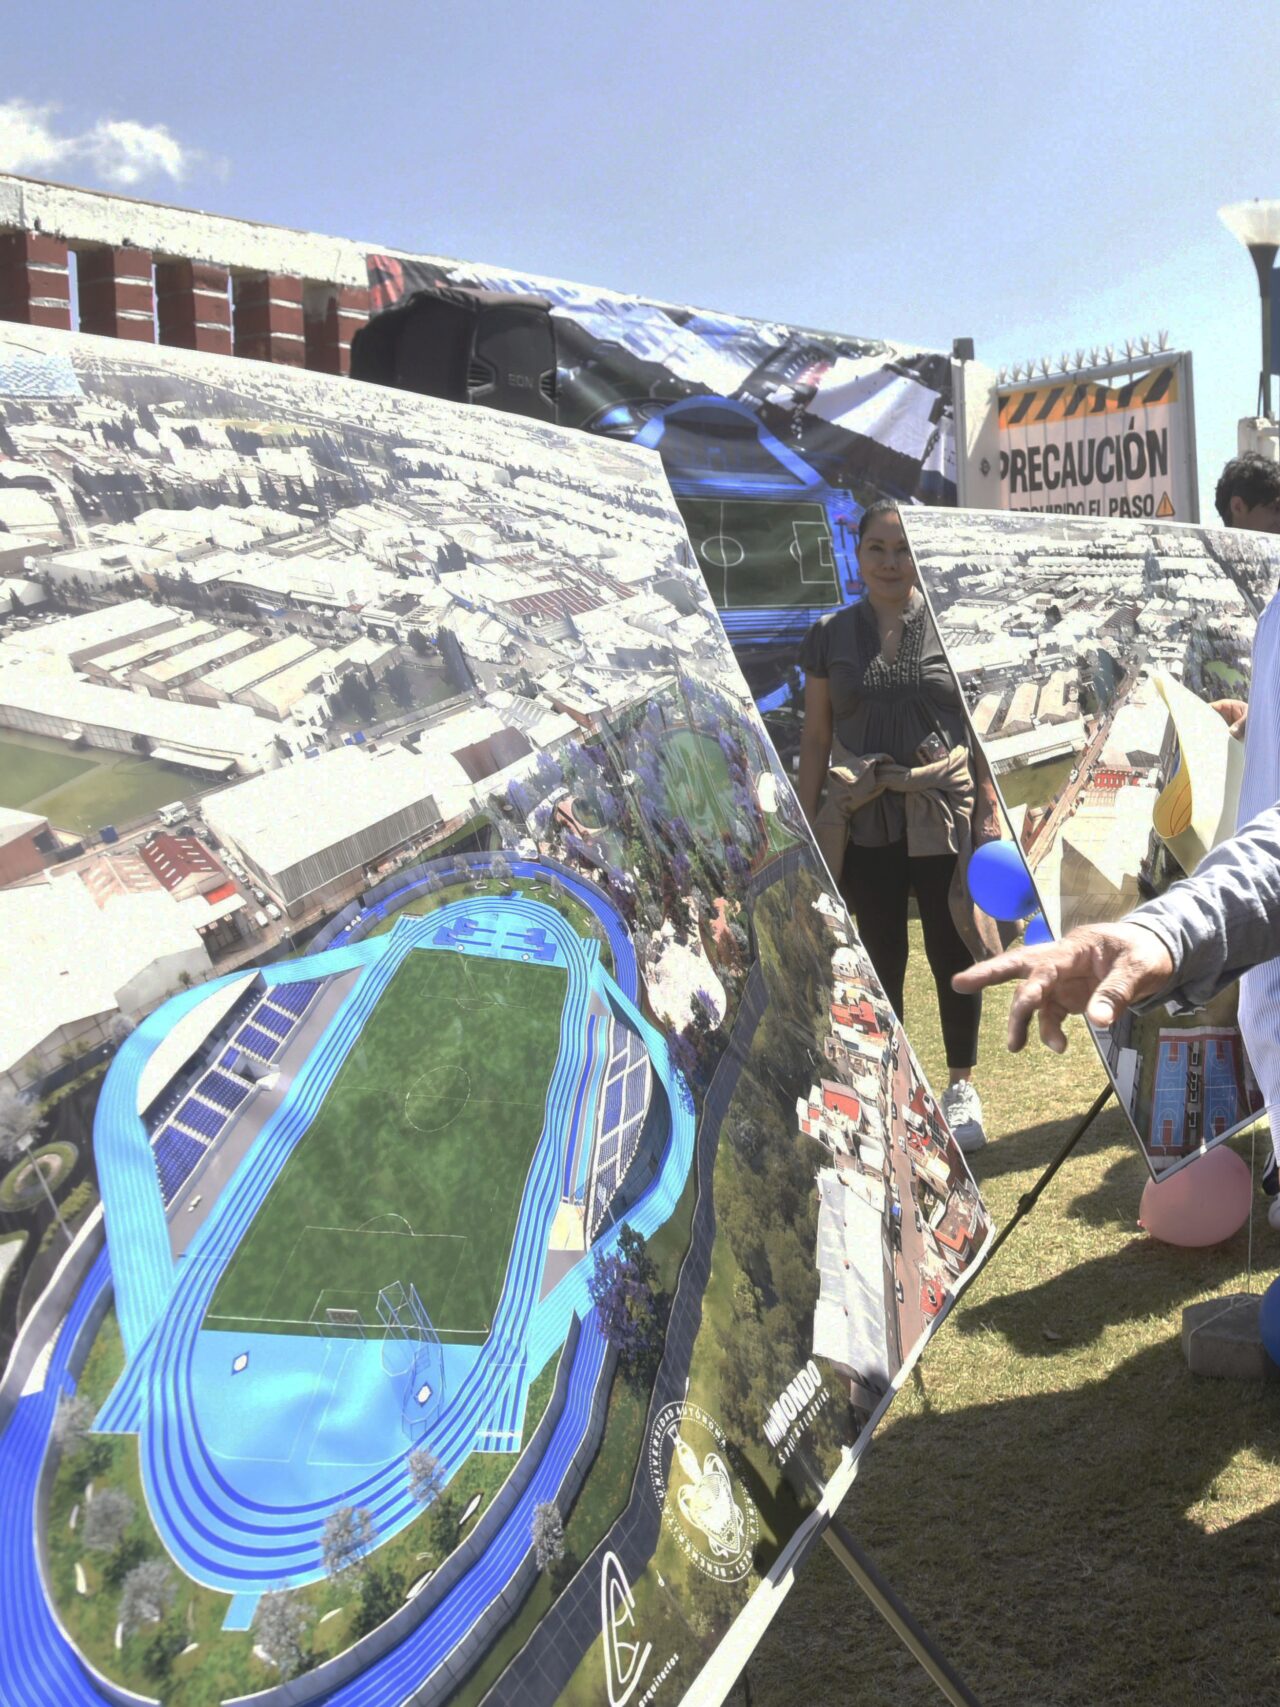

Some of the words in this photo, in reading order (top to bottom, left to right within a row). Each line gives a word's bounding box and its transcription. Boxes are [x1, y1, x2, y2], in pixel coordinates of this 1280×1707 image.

[1089, 499, 1101, 516] EL
[1108, 493, 1154, 519] PASO
[651, 1408, 674, 1499] UNIVERSIDAD
